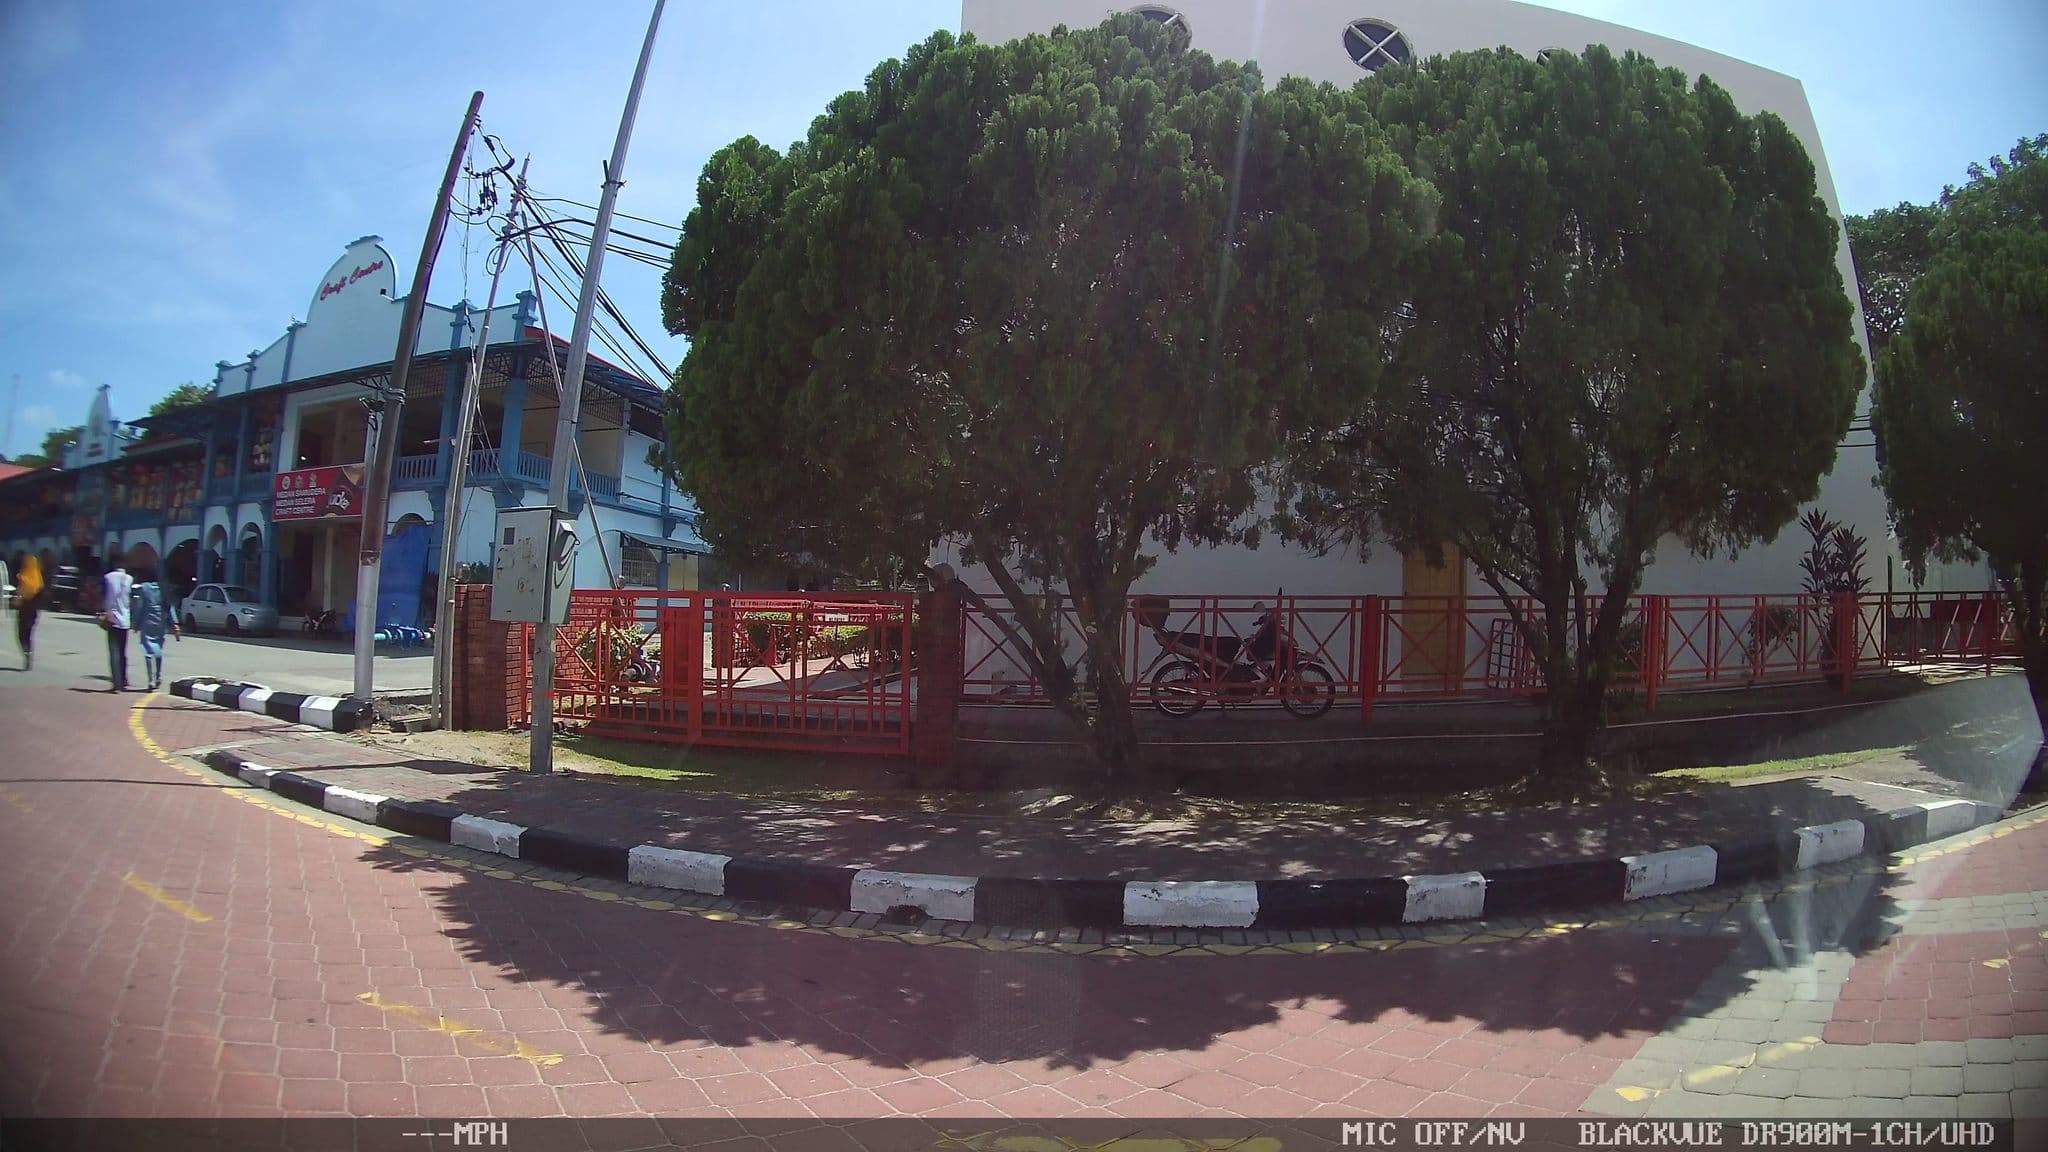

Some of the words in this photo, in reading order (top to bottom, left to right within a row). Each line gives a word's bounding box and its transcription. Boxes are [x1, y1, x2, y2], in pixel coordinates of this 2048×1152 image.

[320, 276, 348, 301] Craft
[349, 260, 384, 284] Centre
[275, 507, 292, 515] CRAFT
[293, 506, 315, 514] CENTRE
